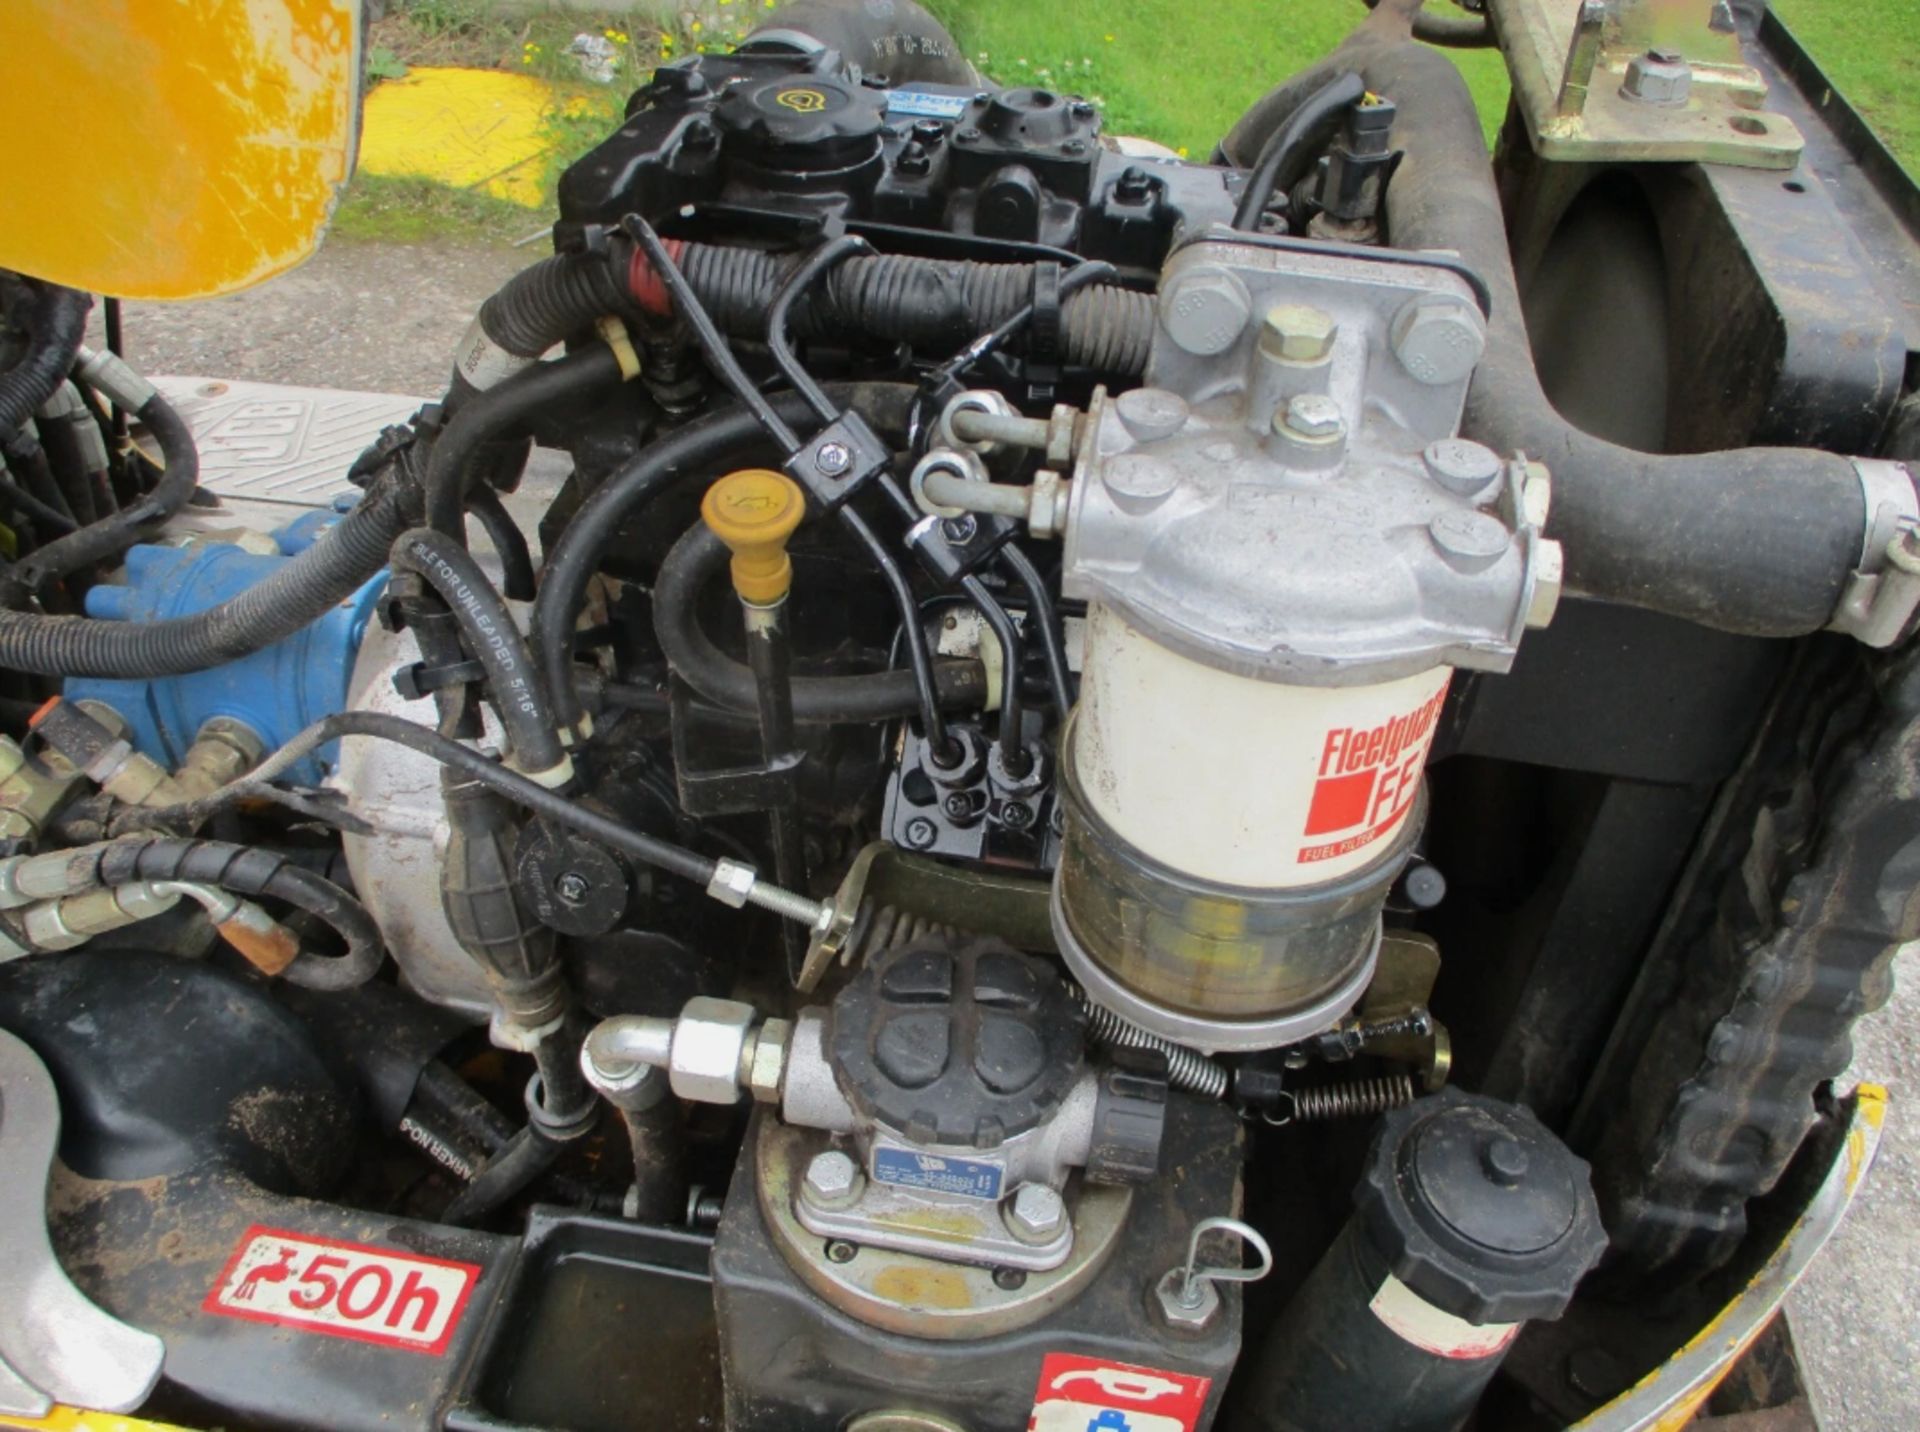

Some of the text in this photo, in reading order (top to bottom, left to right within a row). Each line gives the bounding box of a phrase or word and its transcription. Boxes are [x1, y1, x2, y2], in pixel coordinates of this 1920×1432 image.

[435, 560, 460, 587] FOR
[456, 585, 516, 671] UNLEADED
[1368, 746, 1424, 827] FF
[914, 823, 929, 840] 7
[1303, 829, 1376, 862] FUEL FILTER
[430, 1140, 477, 1184] ARKER
[288, 1255, 440, 1333] 50h
